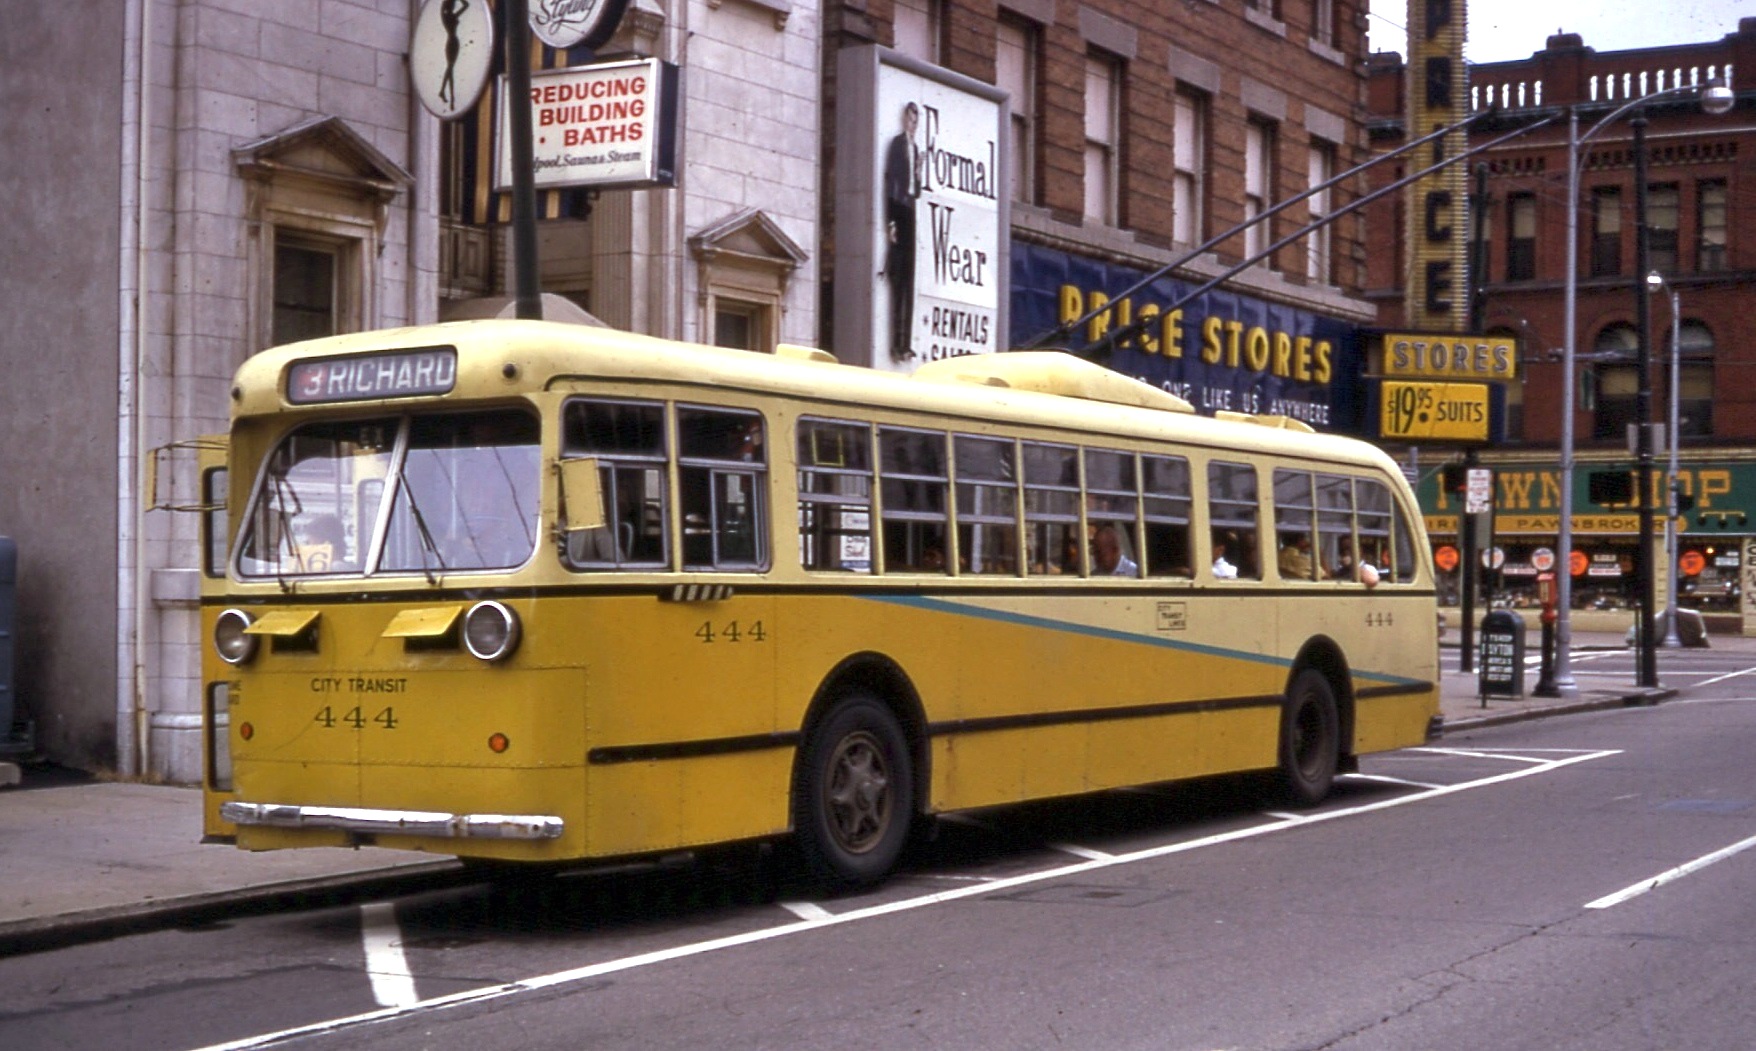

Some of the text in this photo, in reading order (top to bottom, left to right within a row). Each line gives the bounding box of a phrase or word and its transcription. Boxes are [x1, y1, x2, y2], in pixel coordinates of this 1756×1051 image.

[530, 76, 646, 105] REDUCING
[539, 99, 645, 126] BUILDING
[564, 122, 643, 147] BATHS
[607, 150, 641, 163] Steam
[922, 104, 997, 200] Formal
[927, 202, 987, 287] Wear
[931, 306, 988, 345] RENTALS
[1060, 284, 1332, 384] PRICE STORES
[1393, 340, 1510, 372] STORES
[303, 351, 455, 396] 3 RICHARD
[1202, 386, 1232, 410] LIKE
[1243, 391, 1259, 414] US
[1269, 400, 1330, 425] ANYWHERE
[1437, 401, 1483, 422] SUITS
[695, 620, 767, 643] 444
[1365, 611, 1394, 627] 444
[311, 678, 407, 692] CITY TRANSIT
[314, 706, 398, 729] 444
